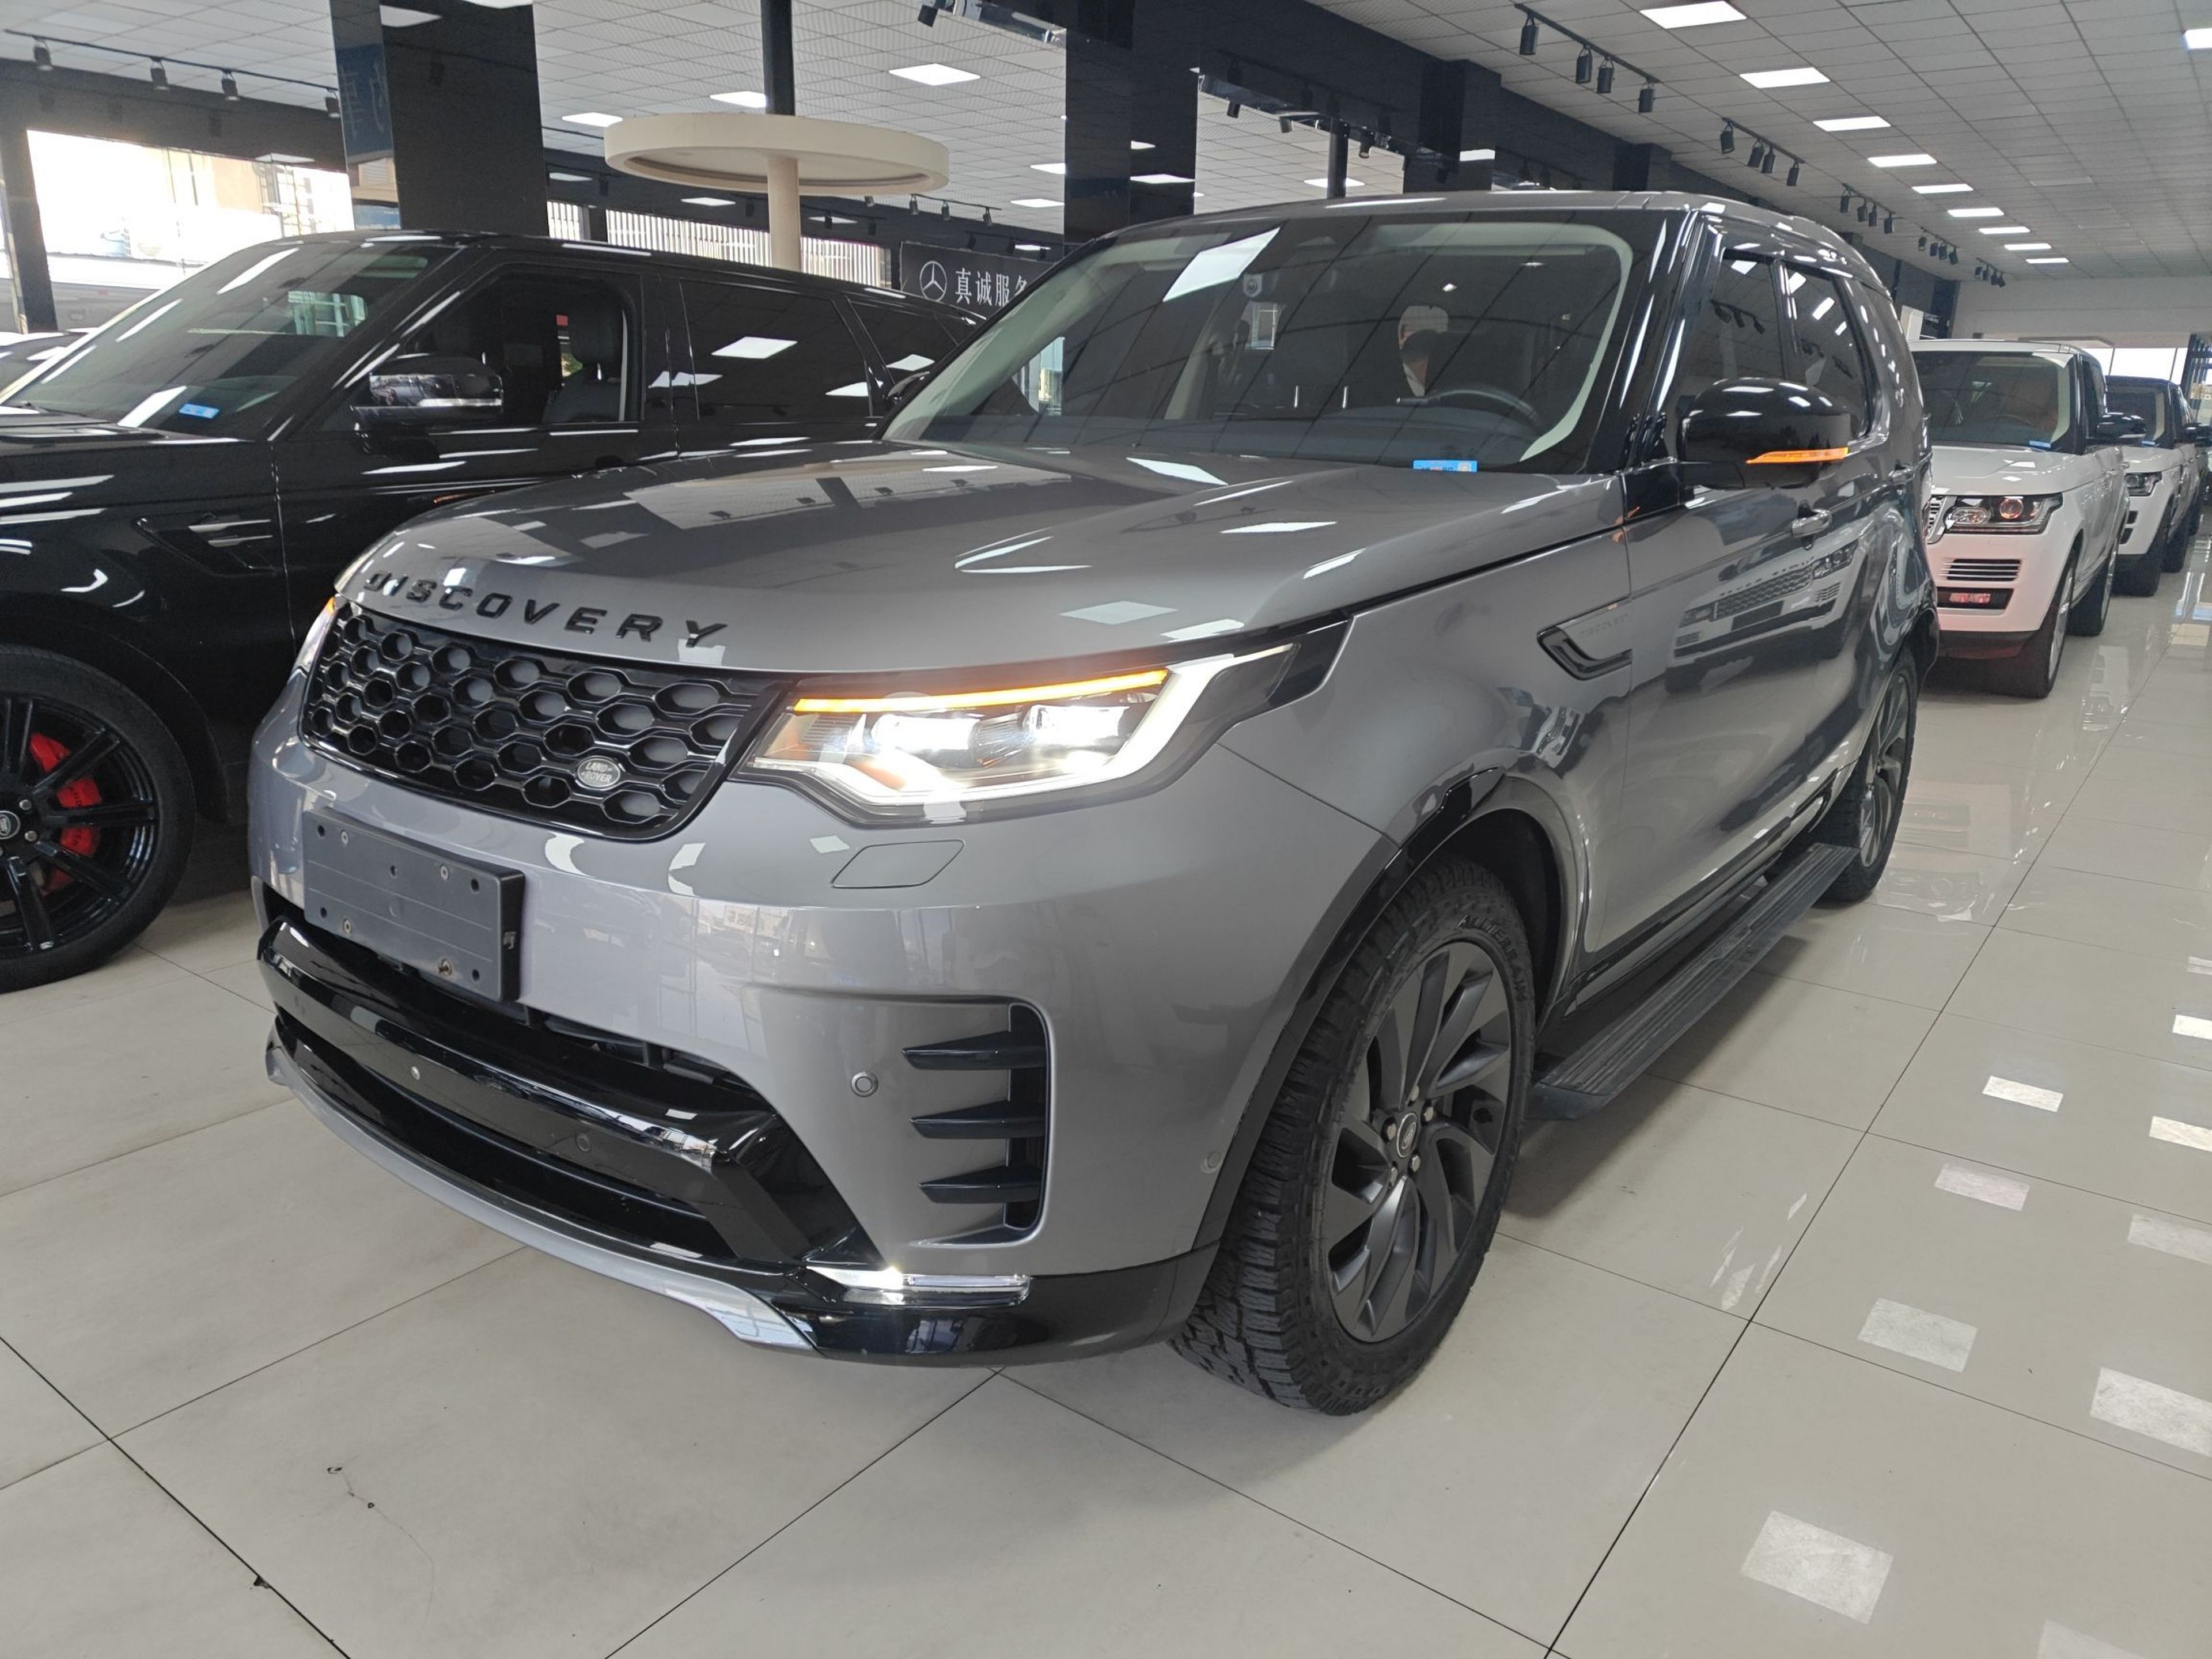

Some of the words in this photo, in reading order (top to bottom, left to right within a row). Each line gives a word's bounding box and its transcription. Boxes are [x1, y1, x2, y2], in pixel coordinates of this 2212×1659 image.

[363, 570, 728, 648] DISCOVERY
[585, 762, 608, 772] LAND
[584, 771, 612, 783] ROVER
